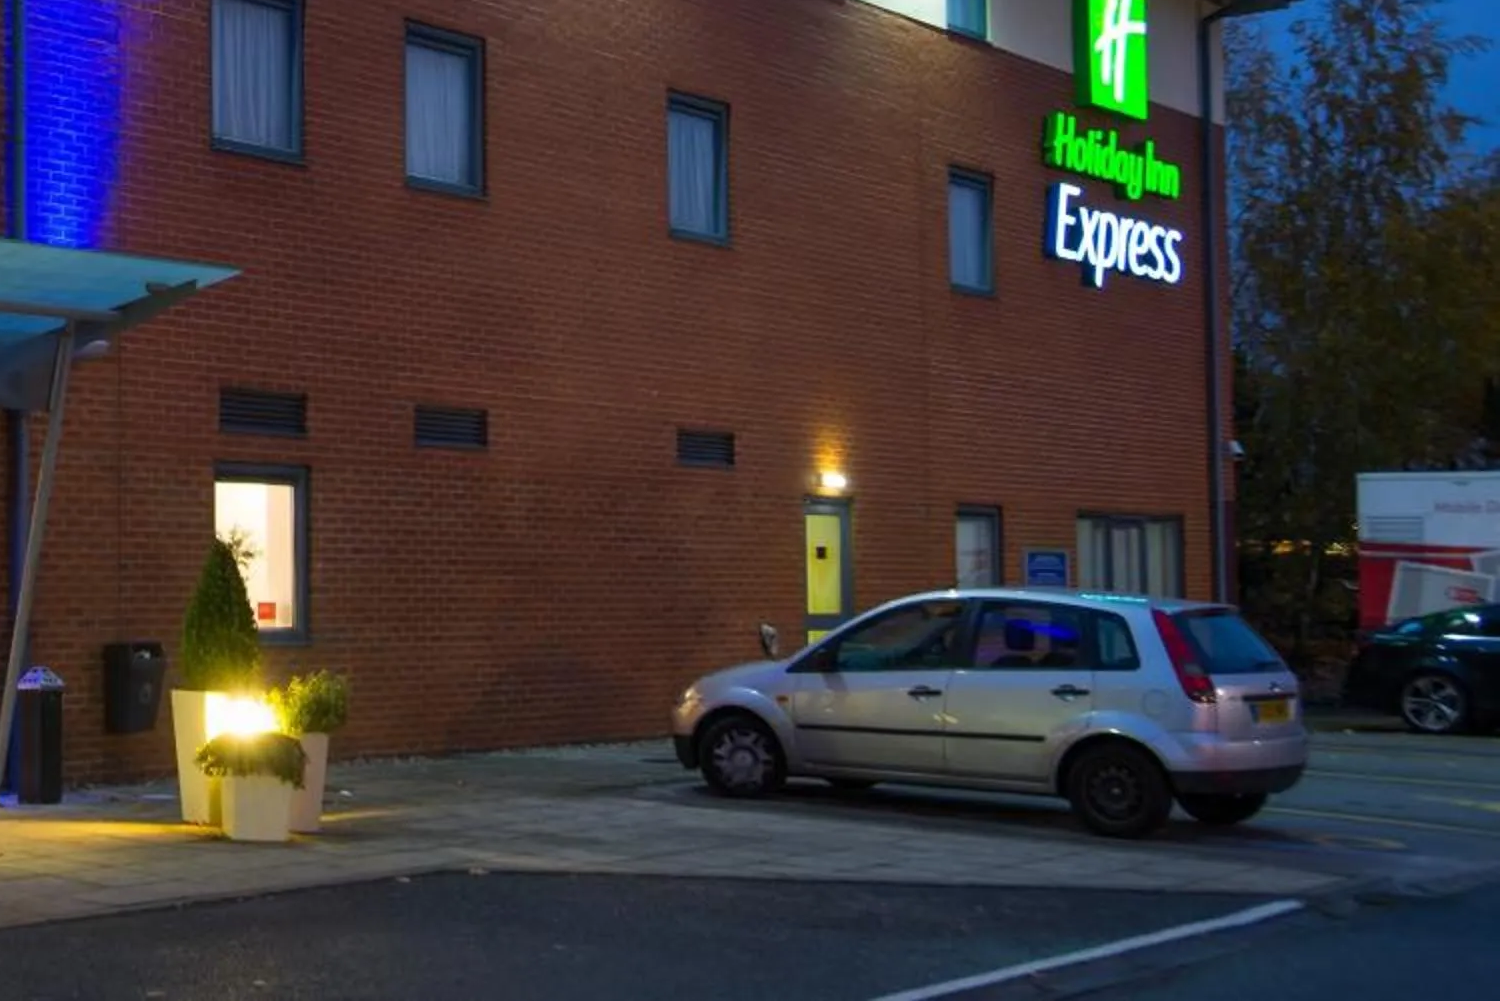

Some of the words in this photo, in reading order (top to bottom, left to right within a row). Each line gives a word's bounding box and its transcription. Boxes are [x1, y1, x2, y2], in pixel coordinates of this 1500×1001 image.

[1054, 112, 1143, 199] Holiday
[1145, 141, 1180, 198] Inn
[1055, 182, 1182, 286] Express
